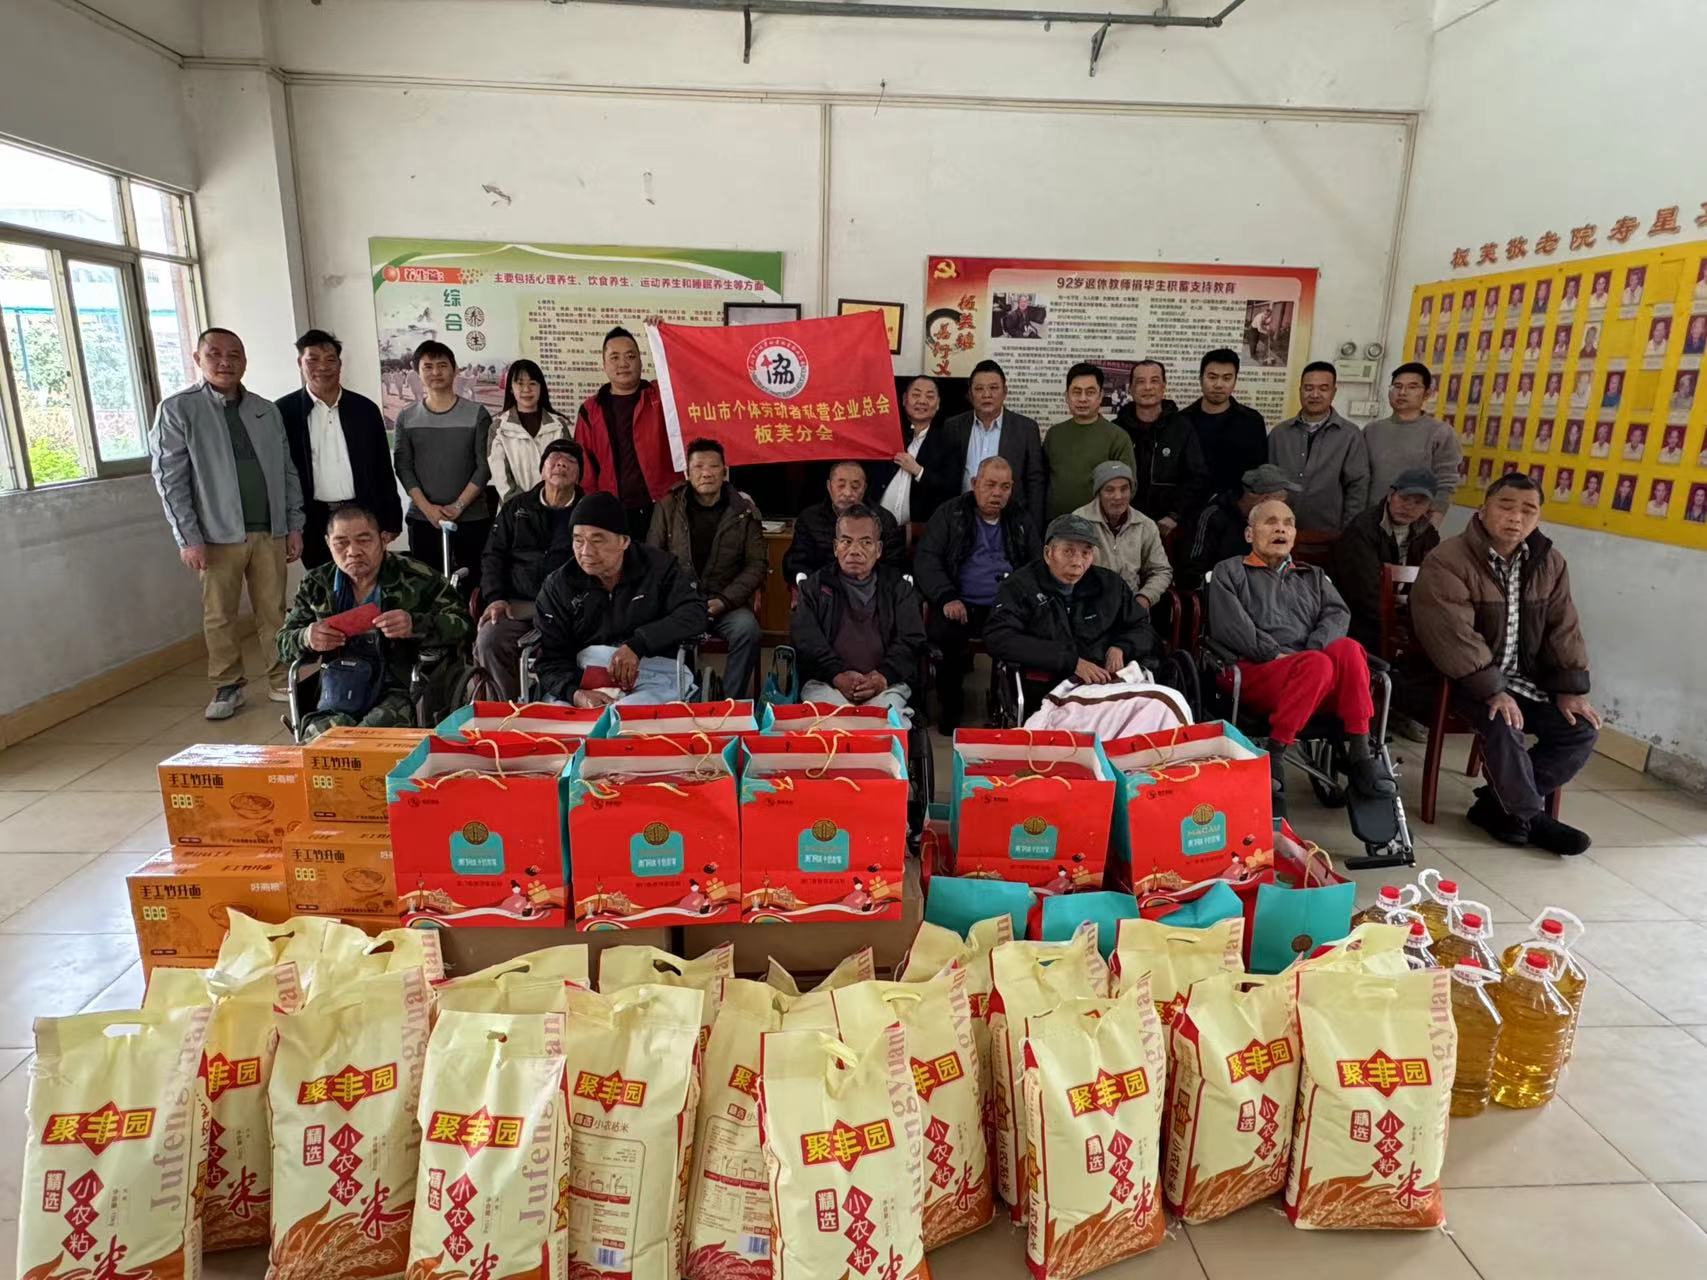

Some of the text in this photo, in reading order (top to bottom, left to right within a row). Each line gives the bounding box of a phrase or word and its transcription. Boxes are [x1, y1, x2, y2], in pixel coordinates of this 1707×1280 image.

[443, 288, 463, 332] 综合
[687, 394, 891, 423] 中山市个体劳动者私营企业总会
[754, 422, 833, 444] 板芙分会
[168, 773, 224, 787] 手工竹升面
[292, 849, 345, 862] 手工竹升面
[139, 884, 202, 897] 手工竹升面
[208, 1059, 258, 1096] 丰园
[912, 1055, 959, 1096] 丰园
[1229, 1041, 1291, 1080] 聚丰园
[1342, 1059, 1428, 1089] 聚丰园
[303, 1067, 394, 1103] 聚丰园
[577, 1074, 644, 1104] 聚丰园
[1071, 1071, 1147, 1111] 聚丰园
[48, 1110, 152, 1144] 聚丰园
[431, 1113, 521, 1147] 聚丰园
[1239, 1102, 1256, 1131] 精选
[1351, 1112, 1371, 1141] 精选
[304, 1127, 324, 1165] 精选
[805, 1121, 890, 1162] 聚丰园
[1086, 1137, 1104, 1172] 精选
[45, 1172, 63, 1211] 精选
[817, 1191, 837, 1231] 精选
